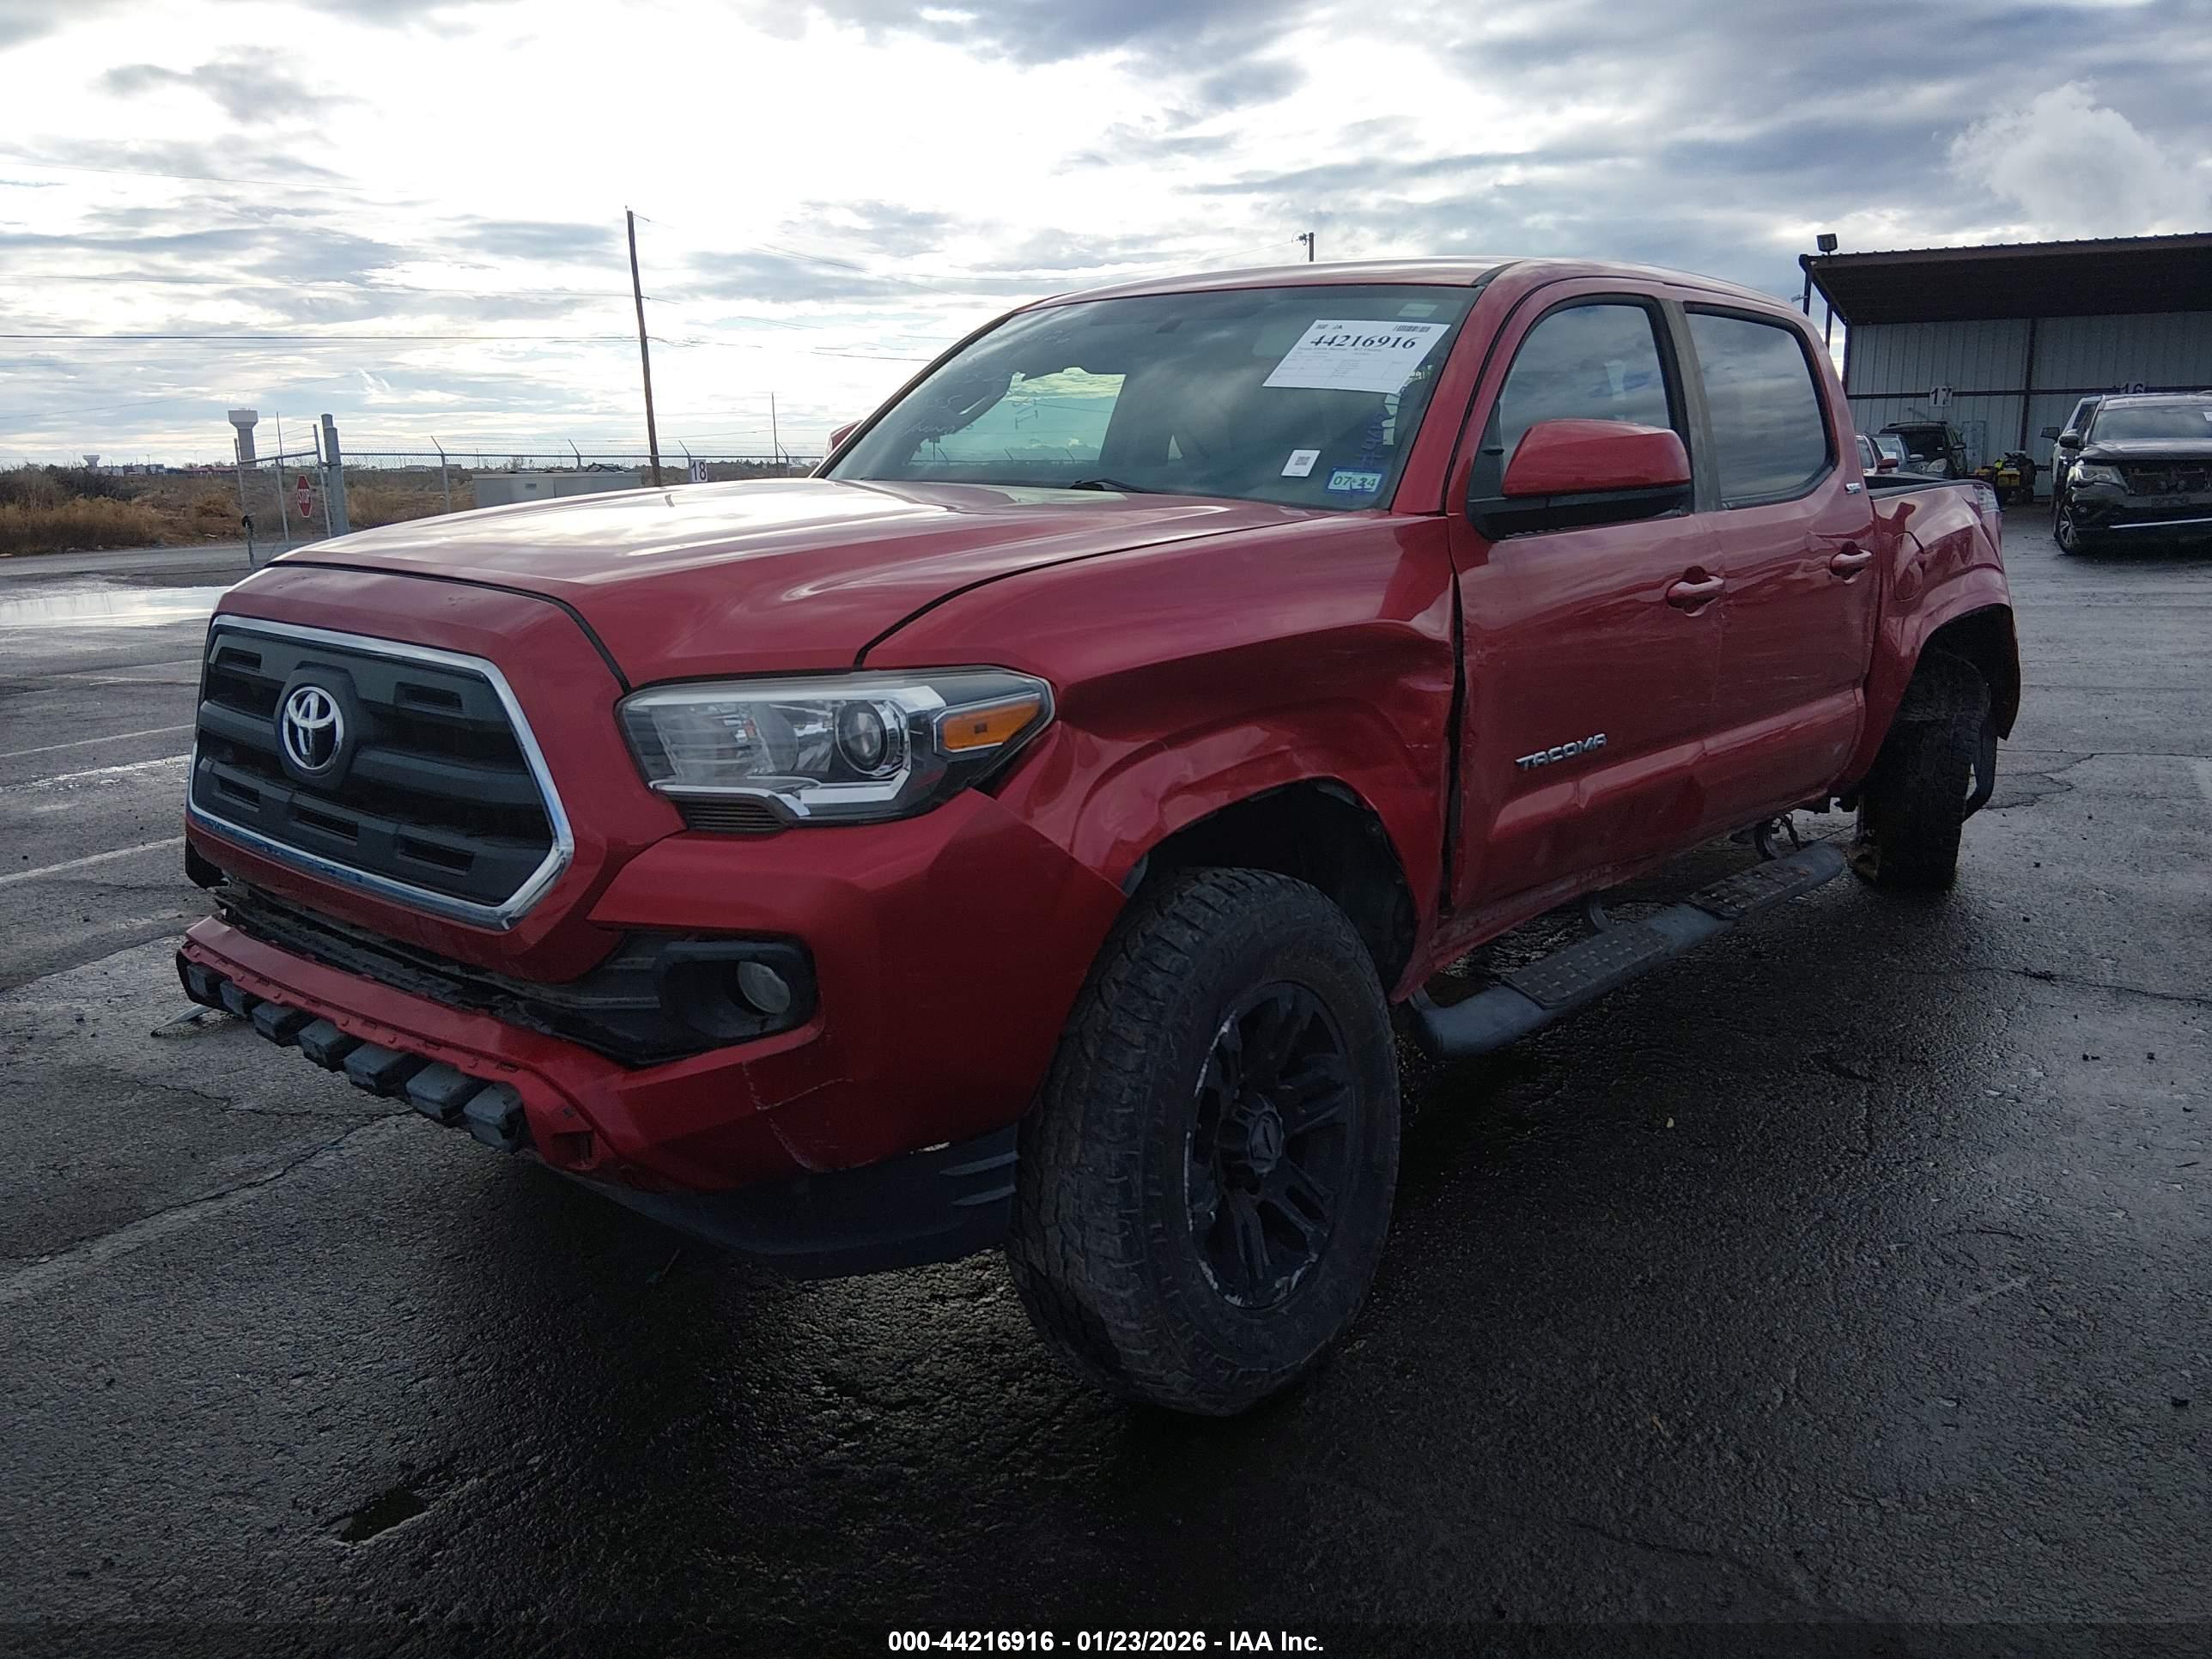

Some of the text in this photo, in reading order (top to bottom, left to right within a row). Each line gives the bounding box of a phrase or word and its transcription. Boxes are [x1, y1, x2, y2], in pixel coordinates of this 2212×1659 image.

[1310, 335, 1421, 350] 44216916
[1930, 387, 1952, 405] 17
[2122, 383, 2143, 394] 16
[691, 461, 707, 481] 18
[297, 488, 310, 504] STOP
[1516, 733, 1607, 770] TACOMA
